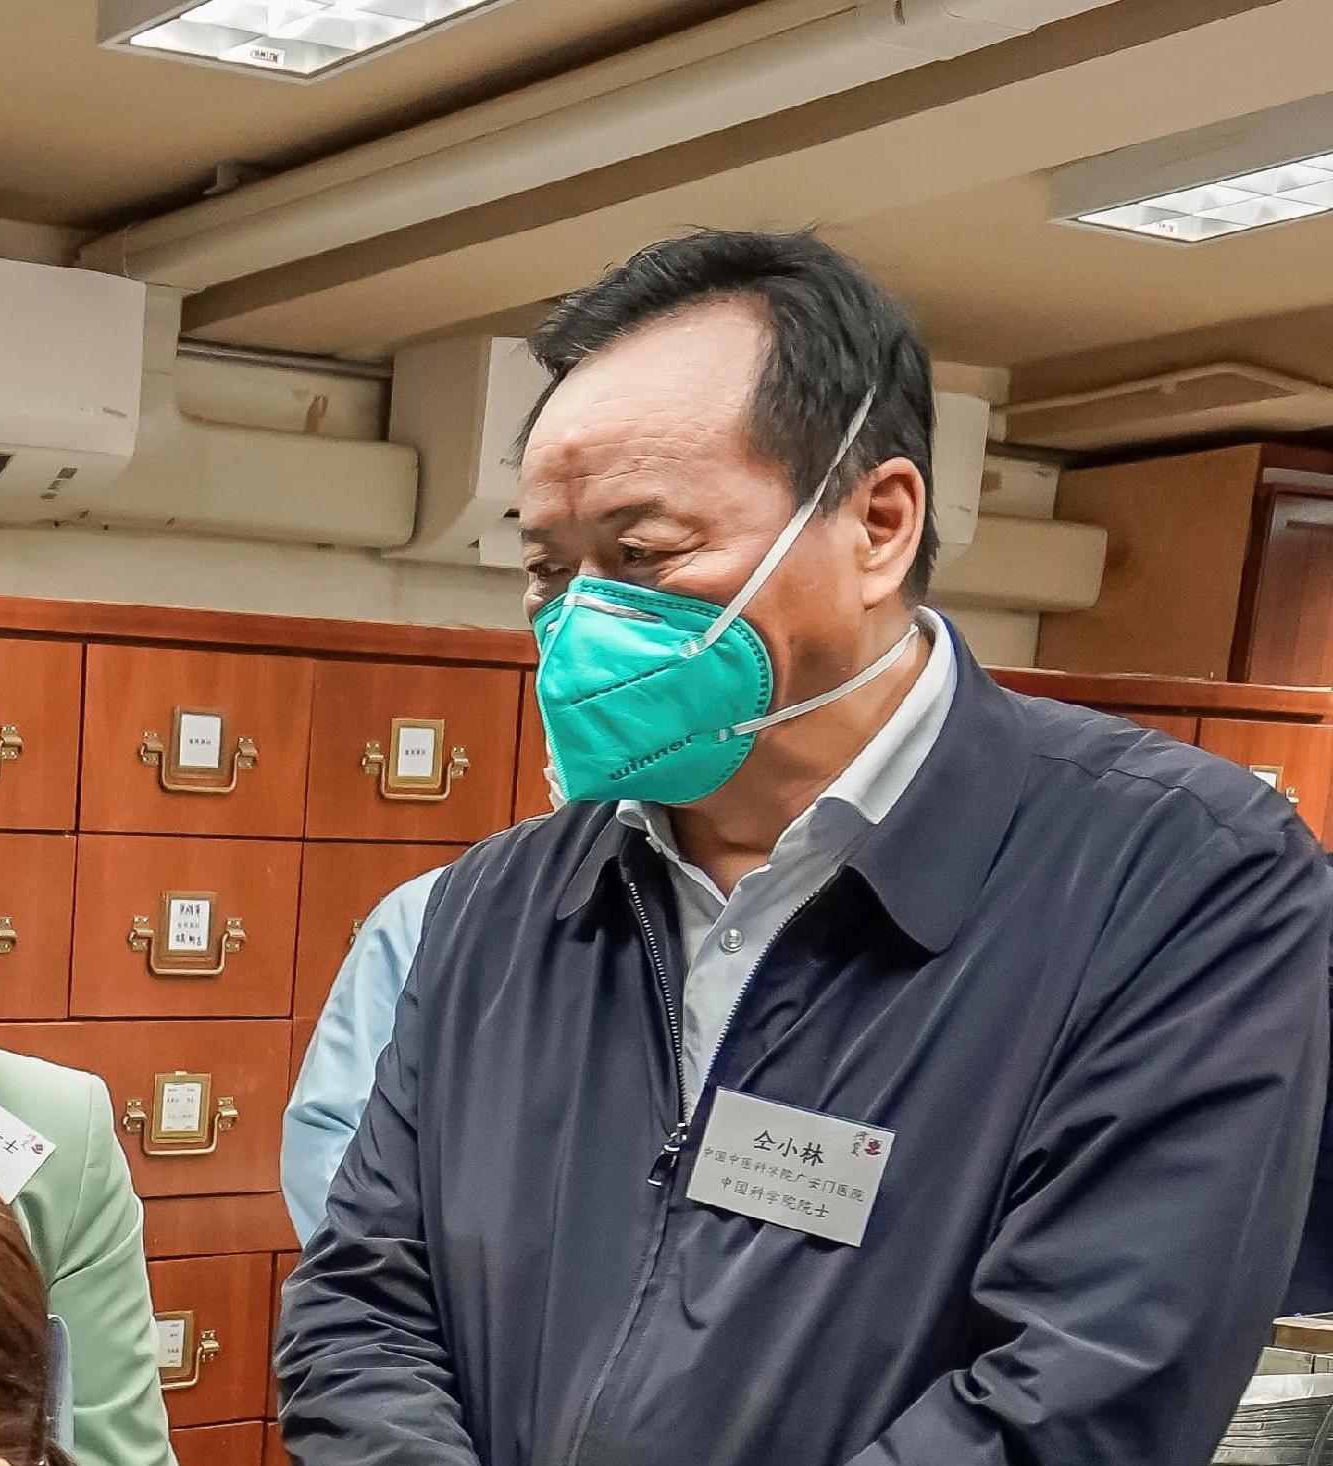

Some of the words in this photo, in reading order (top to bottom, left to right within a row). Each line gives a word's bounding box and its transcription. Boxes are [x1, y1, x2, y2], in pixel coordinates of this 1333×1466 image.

[609, 732, 699, 781] winner
[753, 1129, 825, 1167] 仝小林
[721, 1176, 831, 1218] 中国科学院院士
